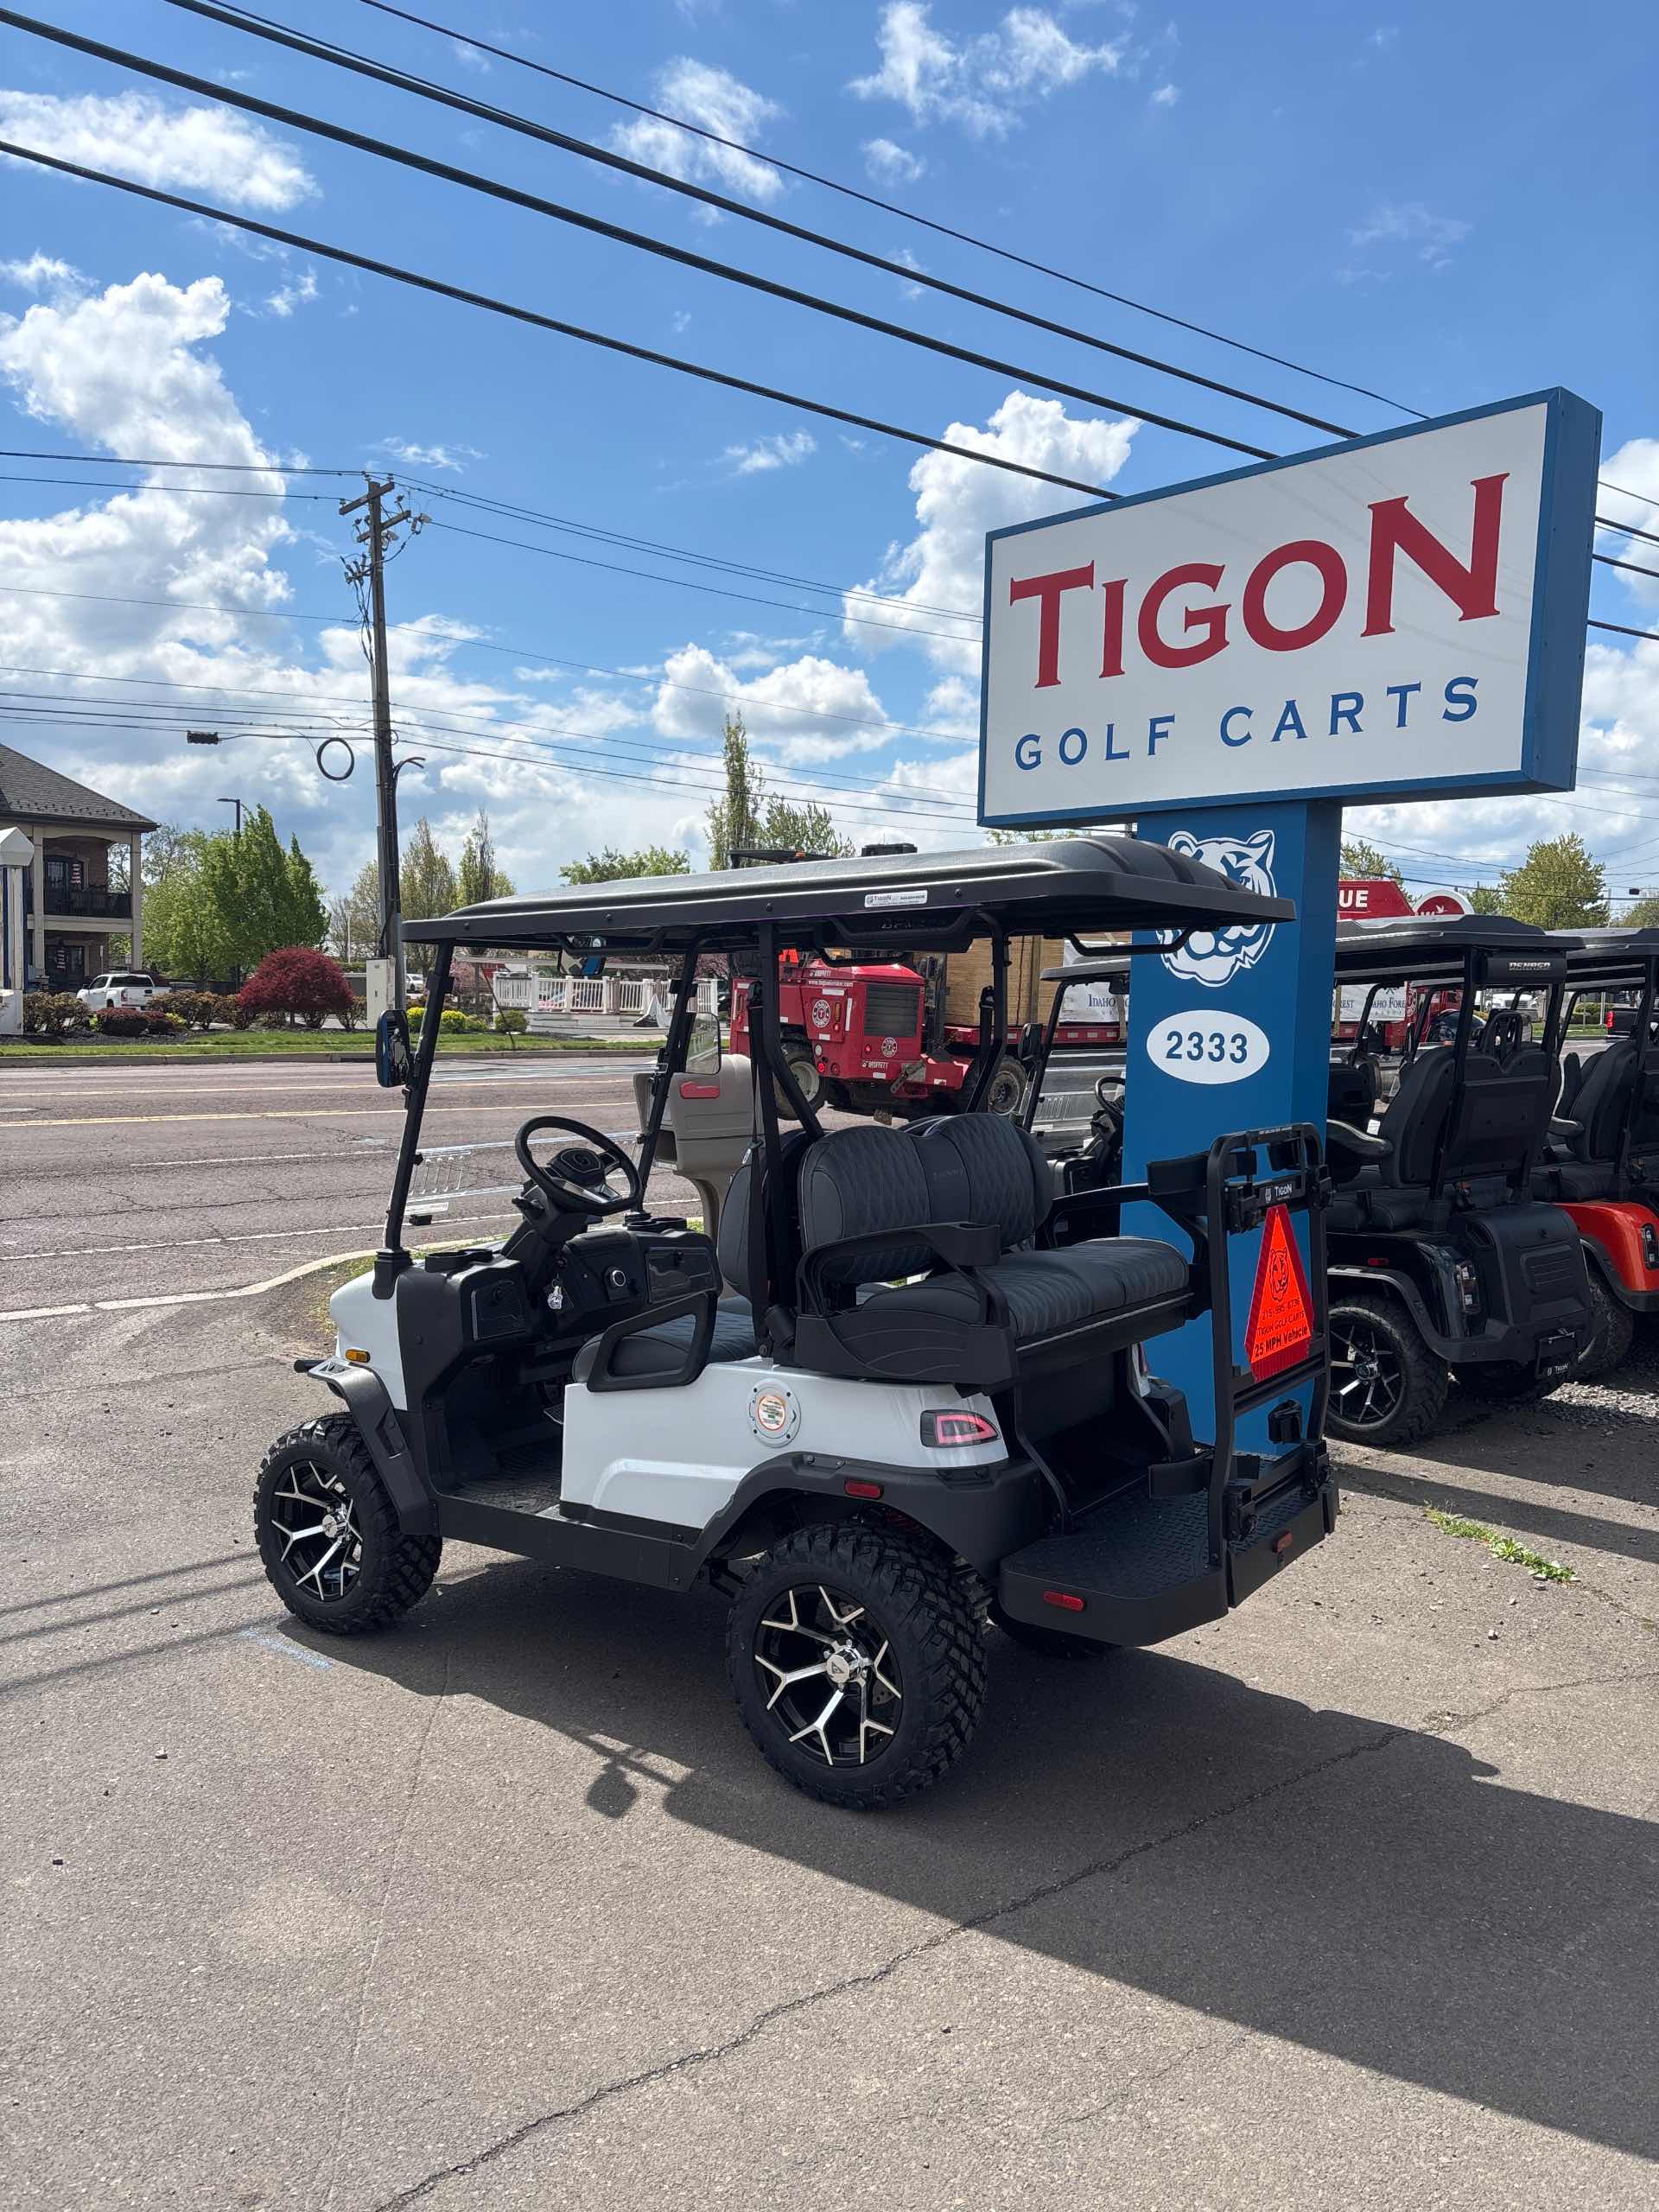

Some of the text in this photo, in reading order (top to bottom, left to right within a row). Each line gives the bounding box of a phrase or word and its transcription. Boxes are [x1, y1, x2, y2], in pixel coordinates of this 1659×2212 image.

[1010, 472, 1511, 689] TIGON
[1014, 677, 1479, 771] GOLF CARTS
[1389, 997, 1407, 1008] FORE
[1165, 1030, 1248, 1064] 2333
[1274, 1183, 1293, 1197] TIGON
[1255, 1326, 1308, 1357] 25 MPH Vehicle
